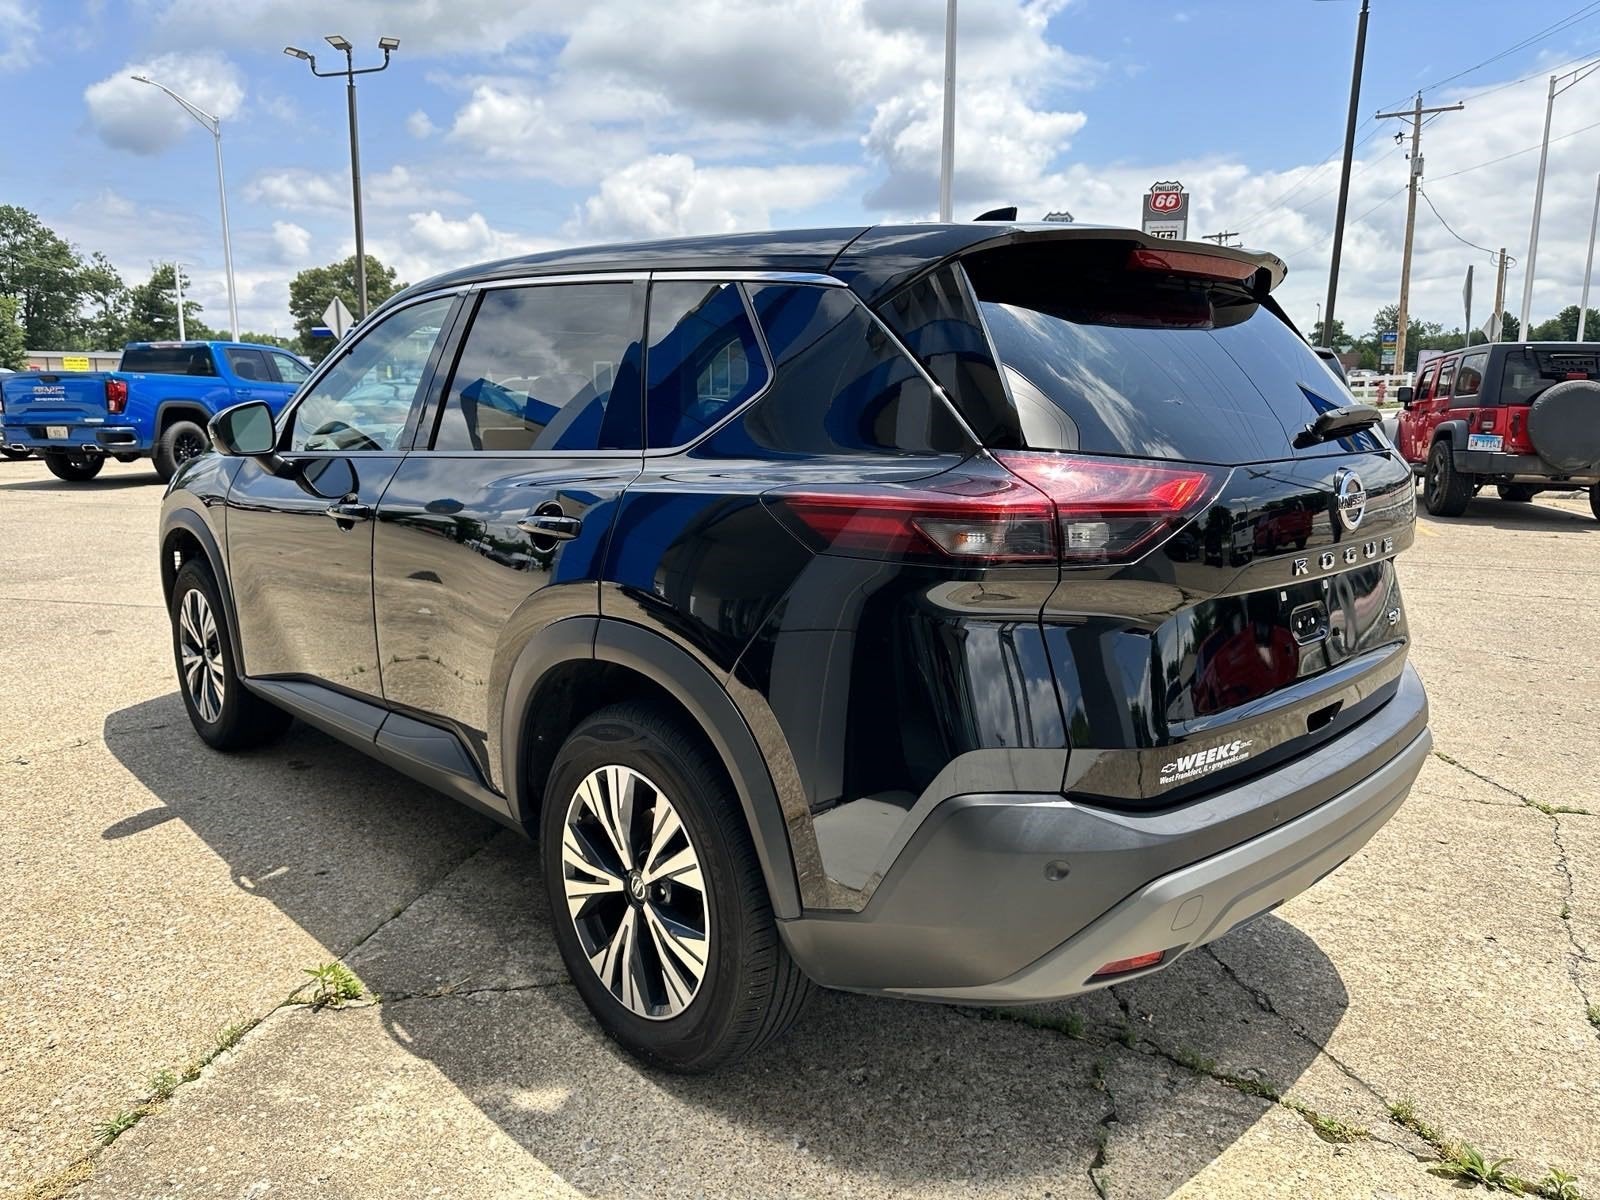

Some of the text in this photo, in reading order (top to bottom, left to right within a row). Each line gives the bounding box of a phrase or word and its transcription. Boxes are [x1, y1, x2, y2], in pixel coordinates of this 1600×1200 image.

[1155, 194, 1177, 207] 66
[32, 386, 65, 394] GMC
[1294, 537, 1393, 576] ROGUE
[1177, 740, 1241, 772] WEEKS
[1160, 774, 1174, 784] West
